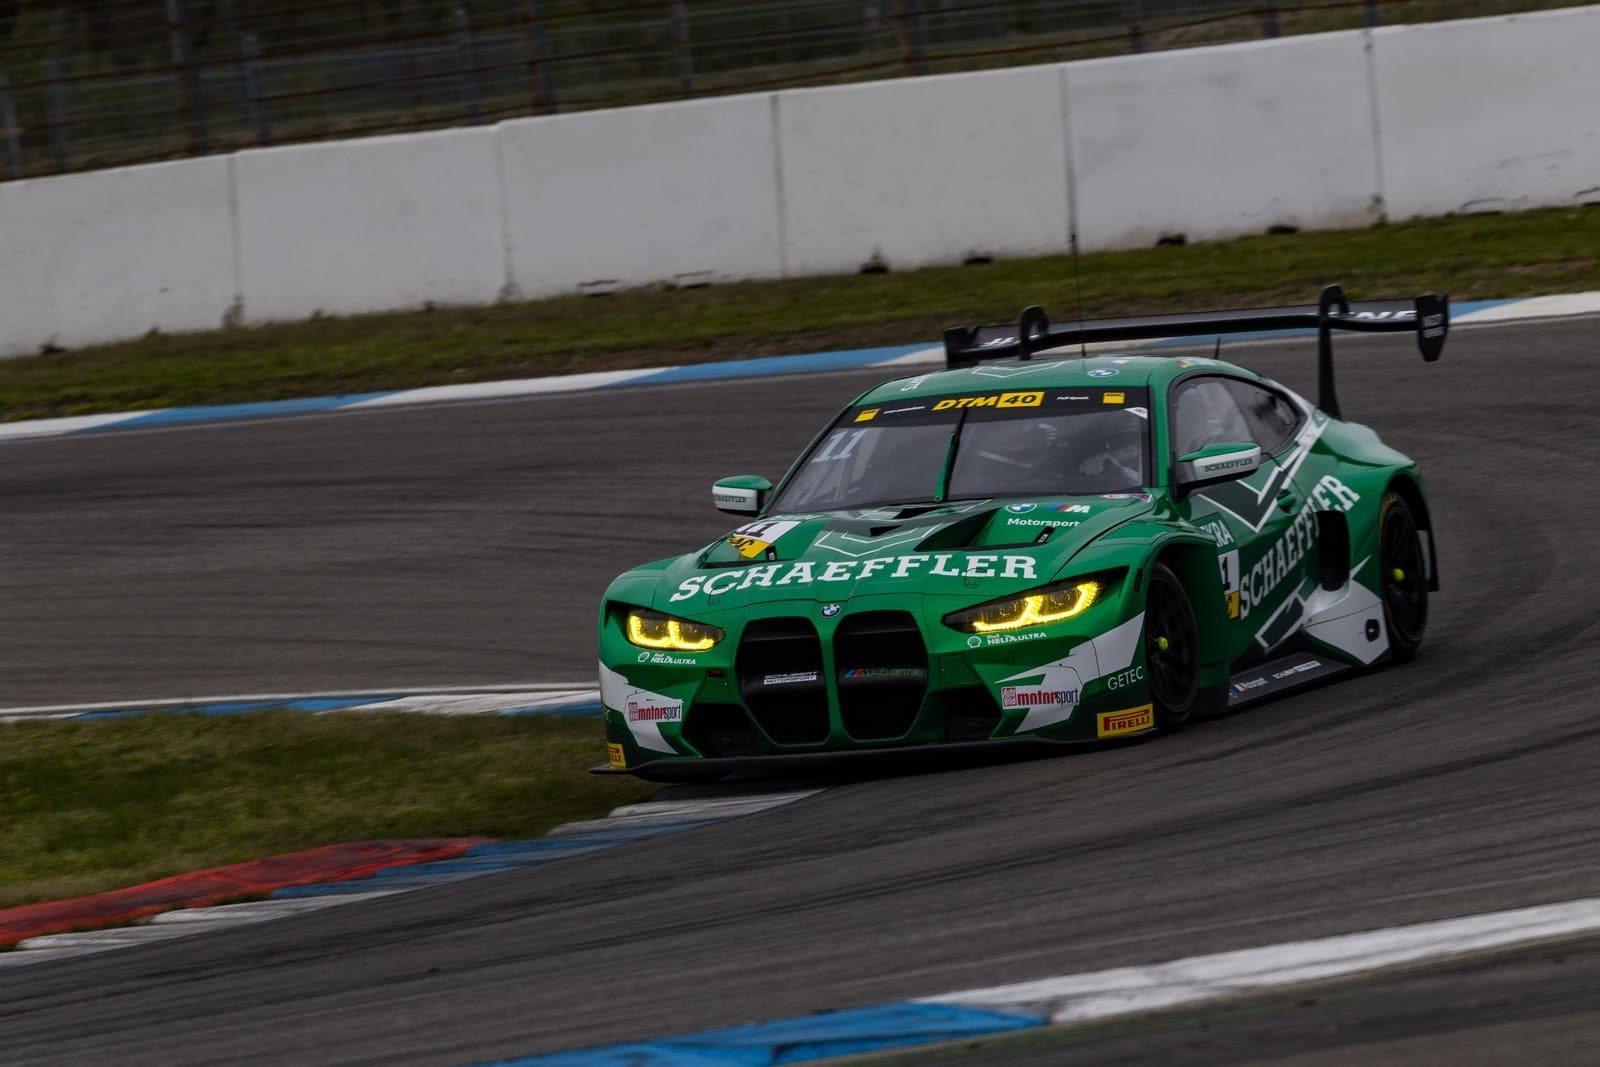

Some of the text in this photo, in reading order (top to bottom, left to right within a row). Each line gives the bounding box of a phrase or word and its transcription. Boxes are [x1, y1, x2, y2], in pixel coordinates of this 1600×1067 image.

[932, 396, 999, 411] DTM
[1003, 394, 1037, 404] 40
[811, 428, 868, 463] 11
[1007, 518, 1081, 527] Motorsport
[669, 554, 1038, 603] SCHAEFFLER
[1018, 631, 1047, 641] ULTRA
[1107, 665, 1144, 690] GETEC
[1103, 708, 1150, 732] PIRELLI
